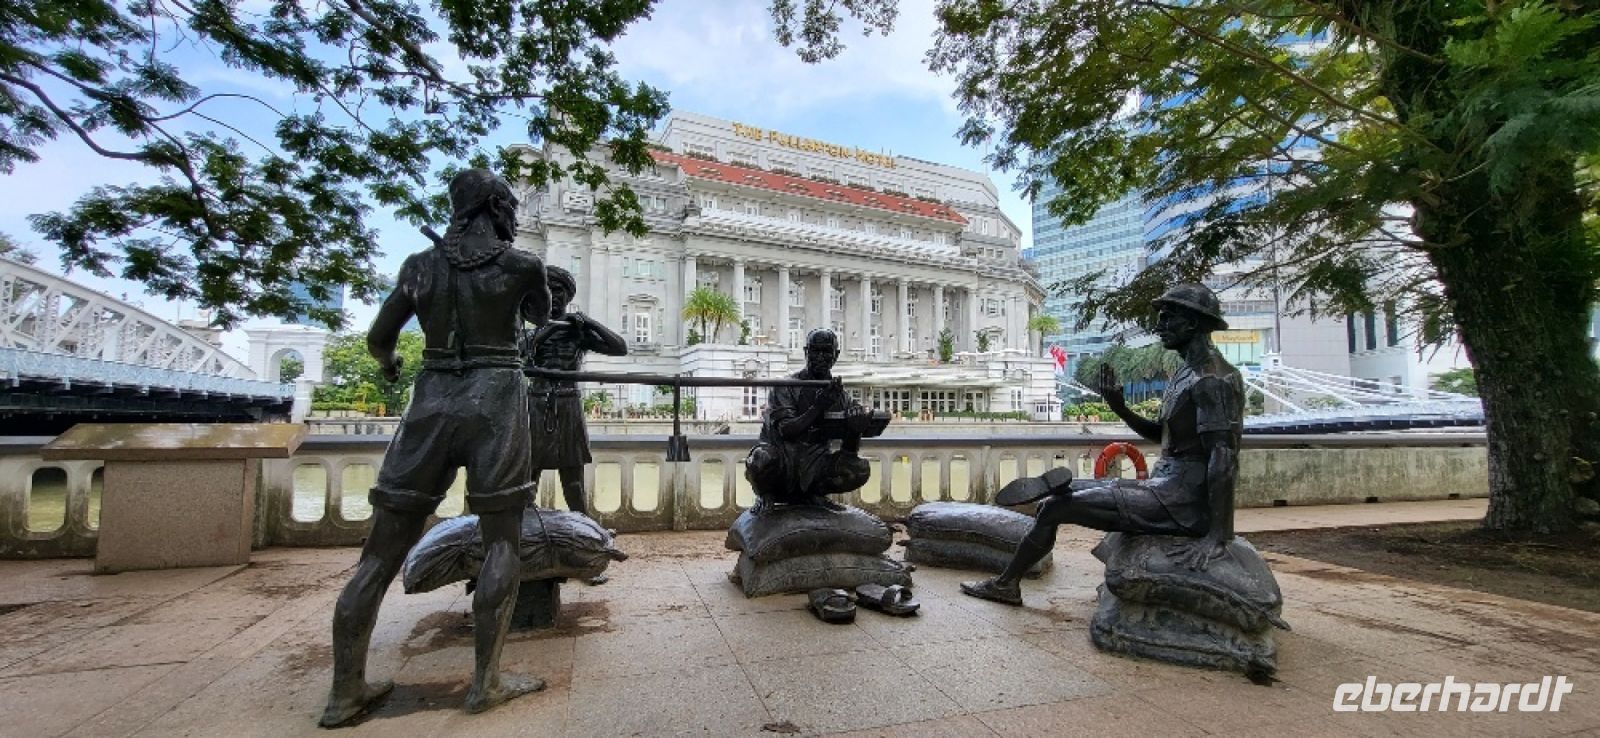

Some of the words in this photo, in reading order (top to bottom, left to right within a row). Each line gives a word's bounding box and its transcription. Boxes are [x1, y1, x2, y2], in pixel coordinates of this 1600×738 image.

[733, 122, 762, 140] THE
[769, 131, 849, 158] FULLERTON
[856, 148, 897, 168] HOTEL
